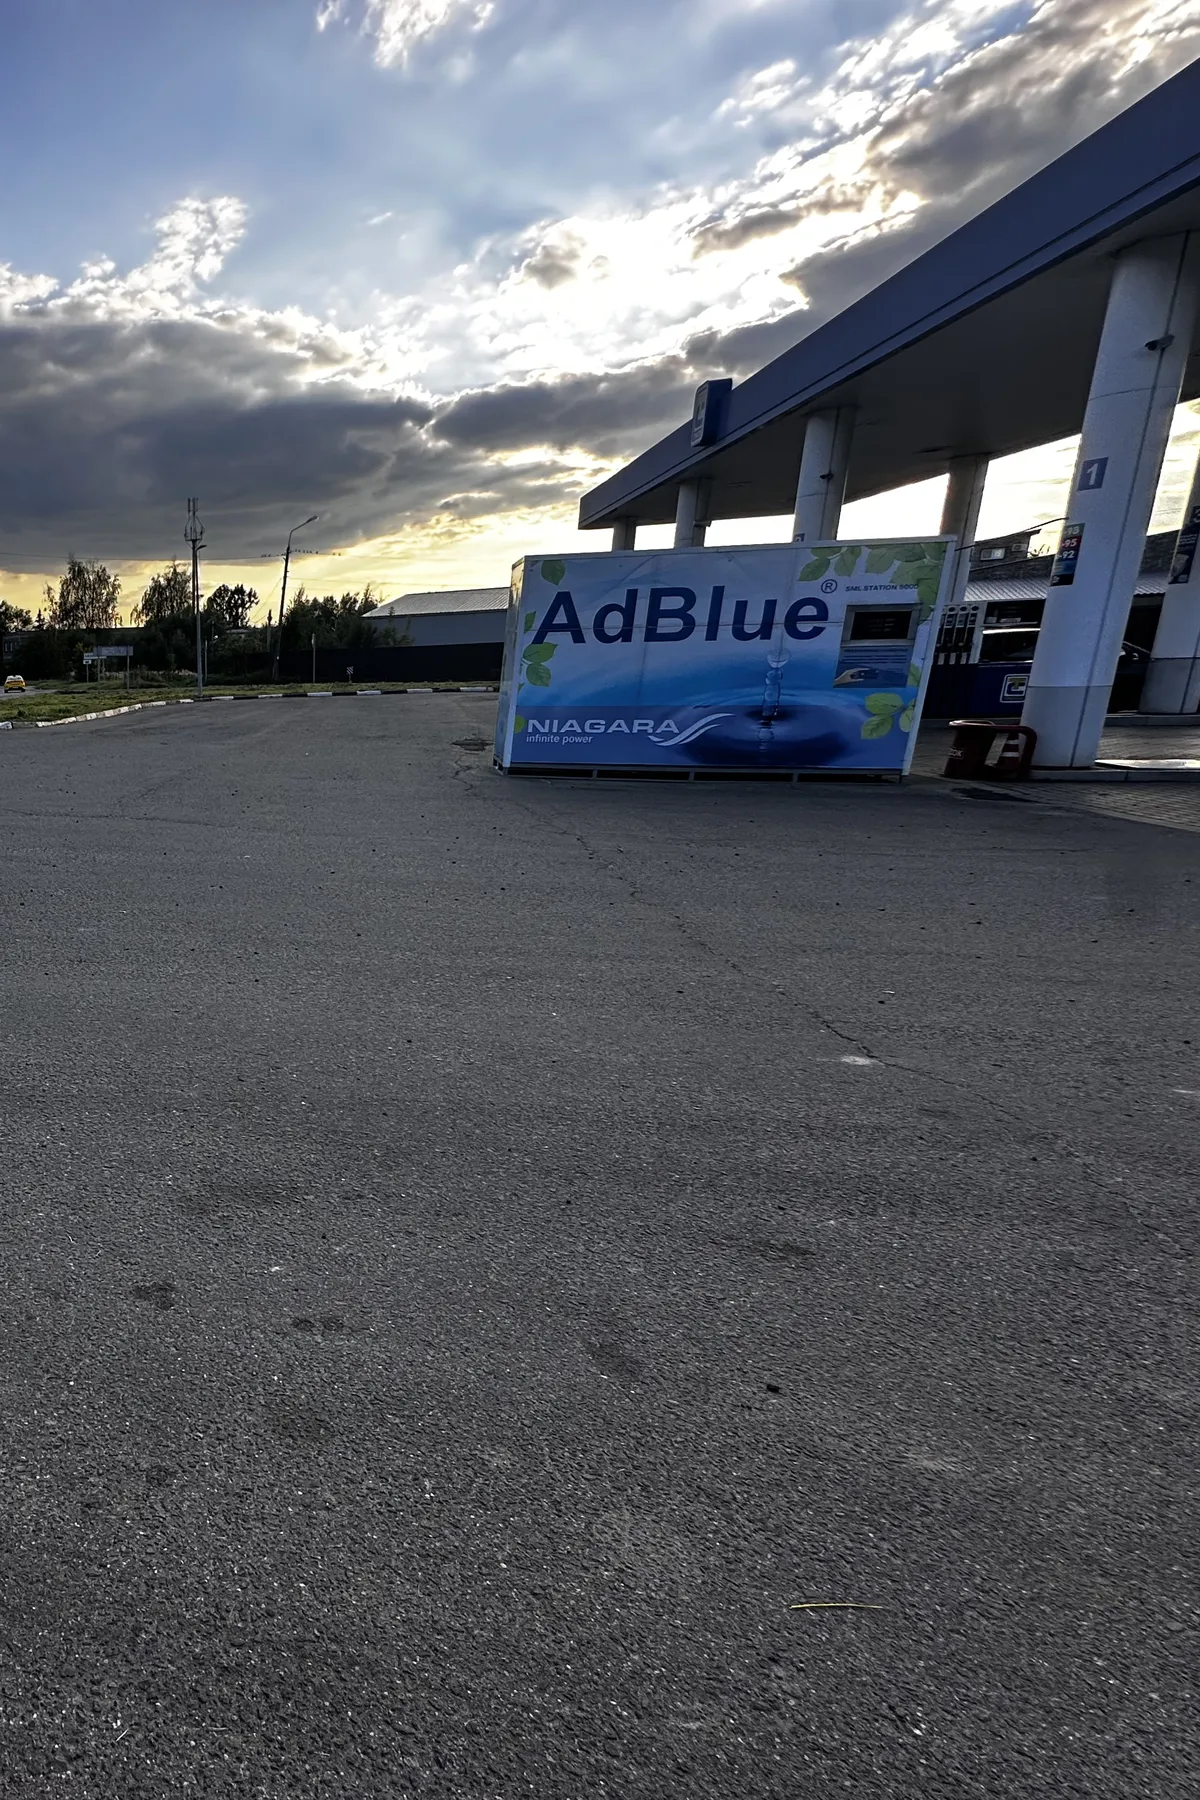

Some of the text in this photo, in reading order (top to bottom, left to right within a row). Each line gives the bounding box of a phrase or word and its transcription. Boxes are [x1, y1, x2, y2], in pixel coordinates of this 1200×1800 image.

[1086, 463, 1099, 486] 1
[531, 585, 829, 645] AdBlue
[527, 719, 680, 733] NIAGARA
[526, 734, 593, 745] infinite power
